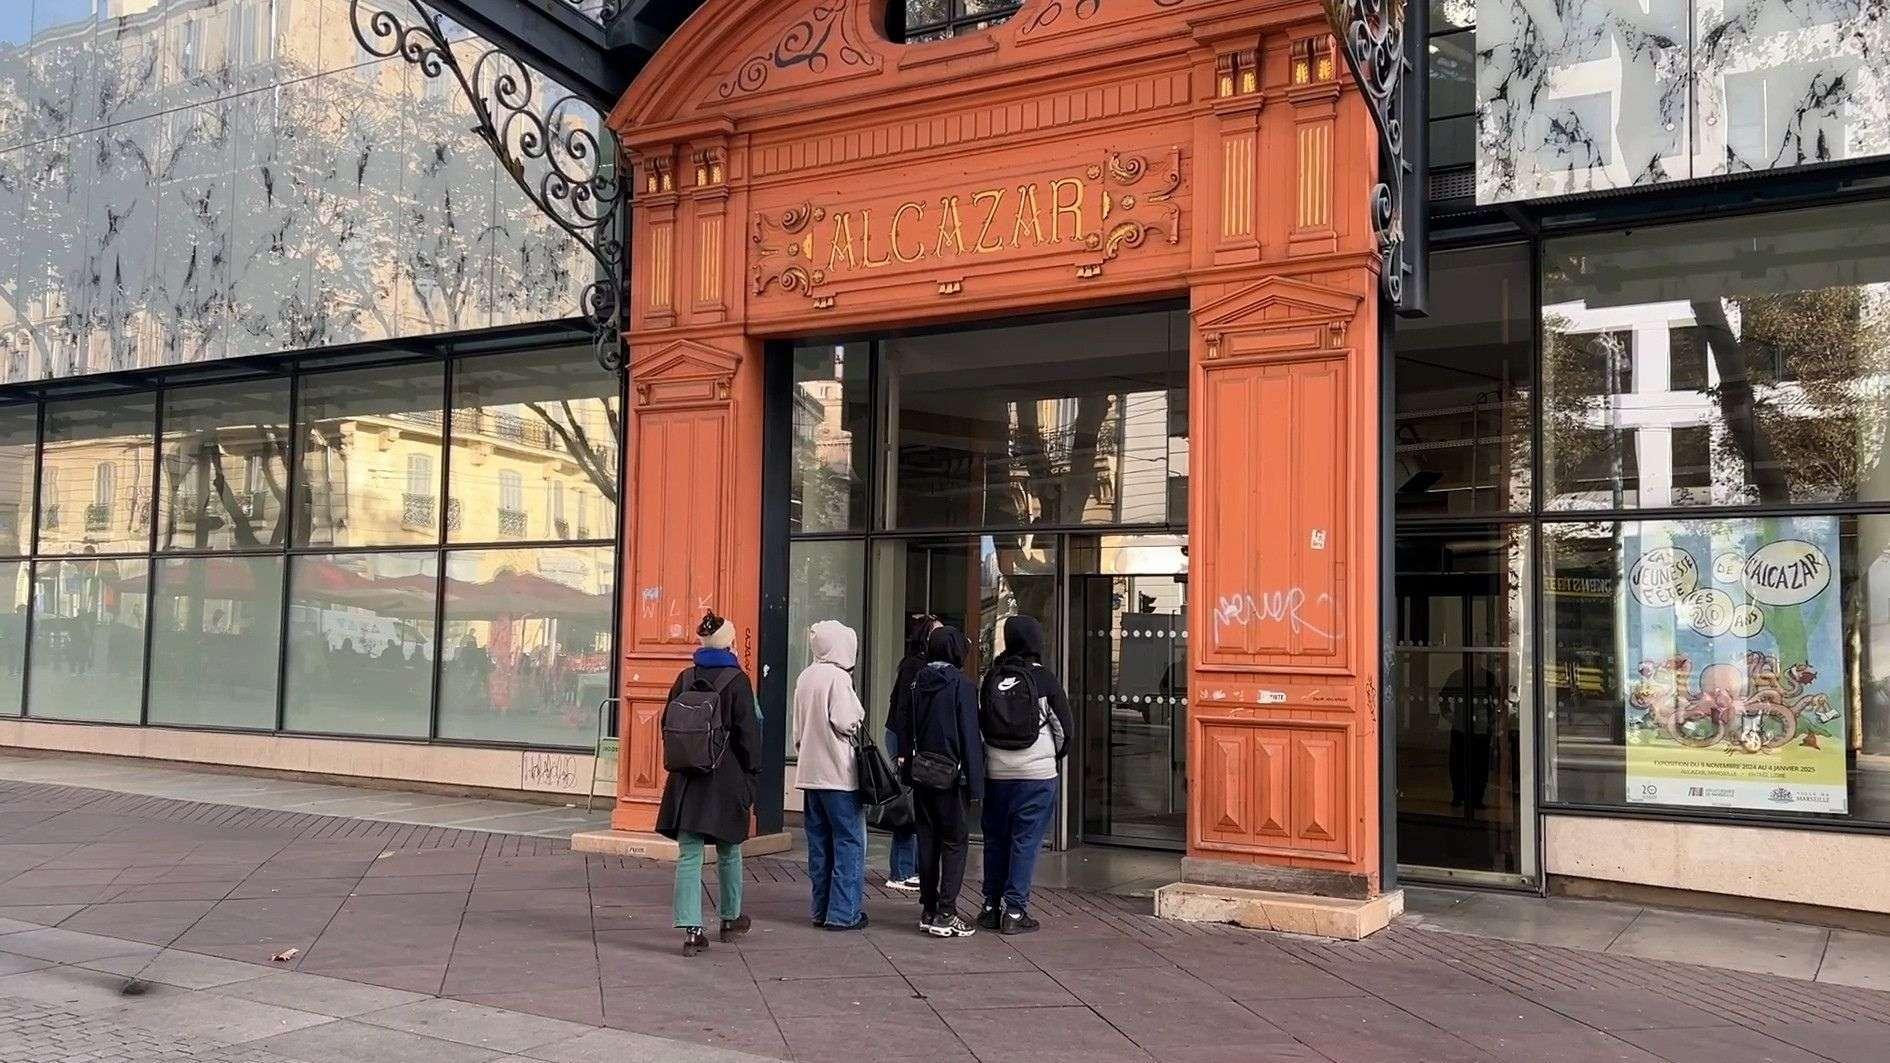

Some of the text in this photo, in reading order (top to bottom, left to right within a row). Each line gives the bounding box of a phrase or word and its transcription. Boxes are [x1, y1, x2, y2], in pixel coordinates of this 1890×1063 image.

[826, 177, 1086, 273] ALCAZAR
[1632, 555, 1693, 586] JEUNESSE
[1716, 562, 1733, 575] DE
[1744, 553, 1823, 590] L'ALCAZAR
[1734, 610, 1758, 628] ANS
